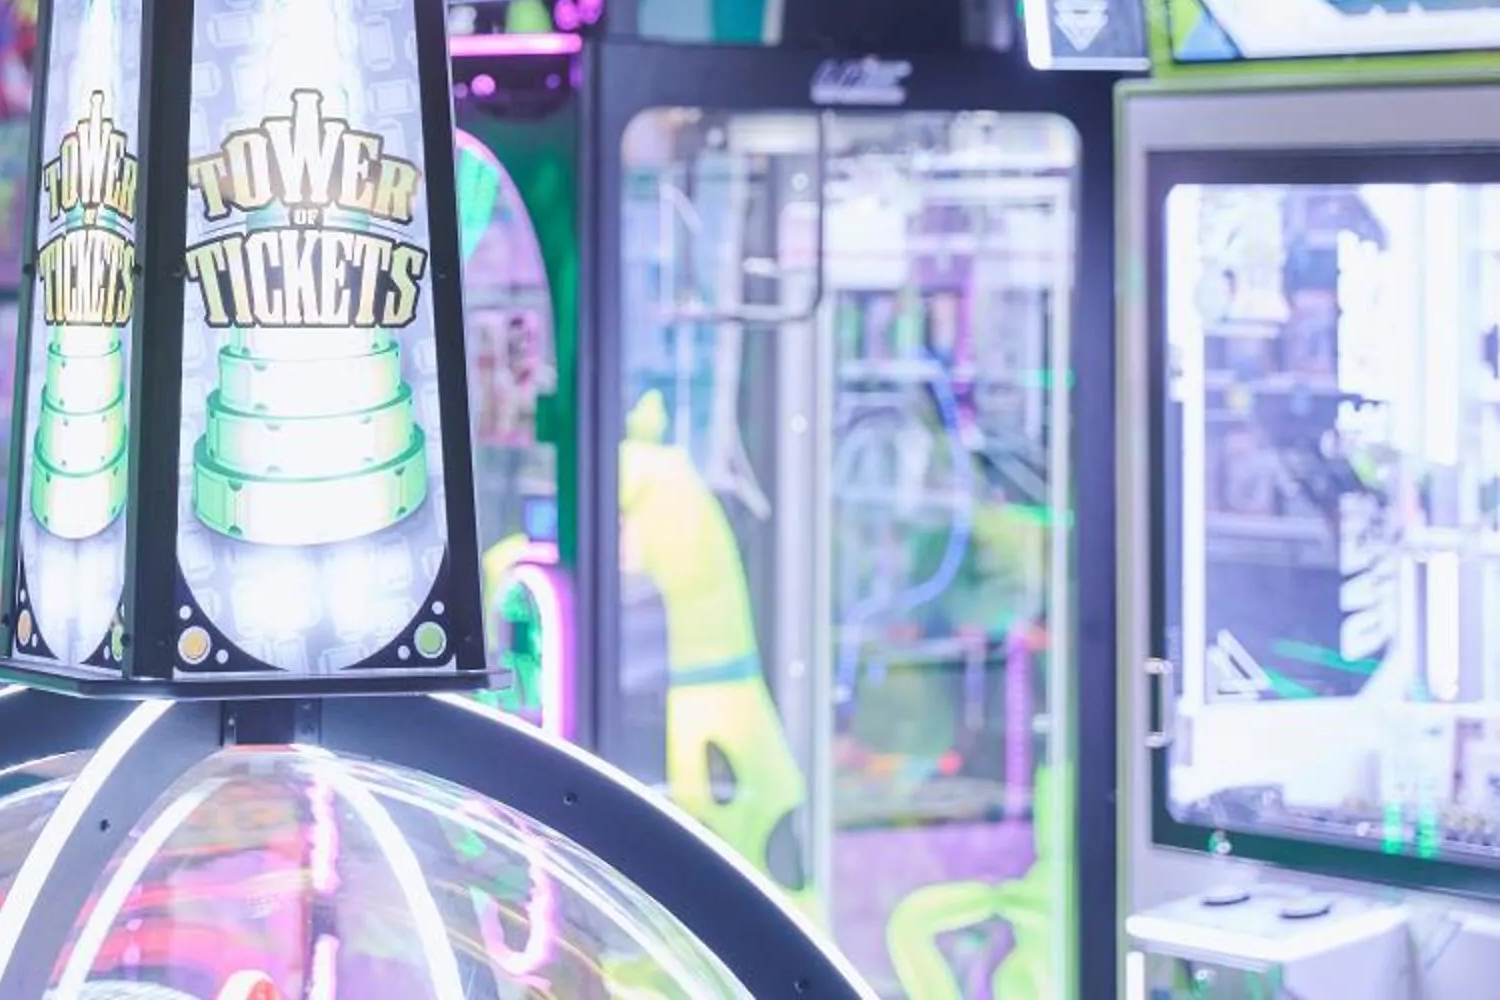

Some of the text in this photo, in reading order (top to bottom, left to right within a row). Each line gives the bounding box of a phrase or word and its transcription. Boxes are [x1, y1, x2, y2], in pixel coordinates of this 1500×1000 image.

[43, 90, 138, 223] TOWER
[189, 88, 421, 225] TOWER
[293, 208, 320, 226] OF
[38, 231, 136, 327] TICKETS
[184, 226, 428, 328] TICKETS
